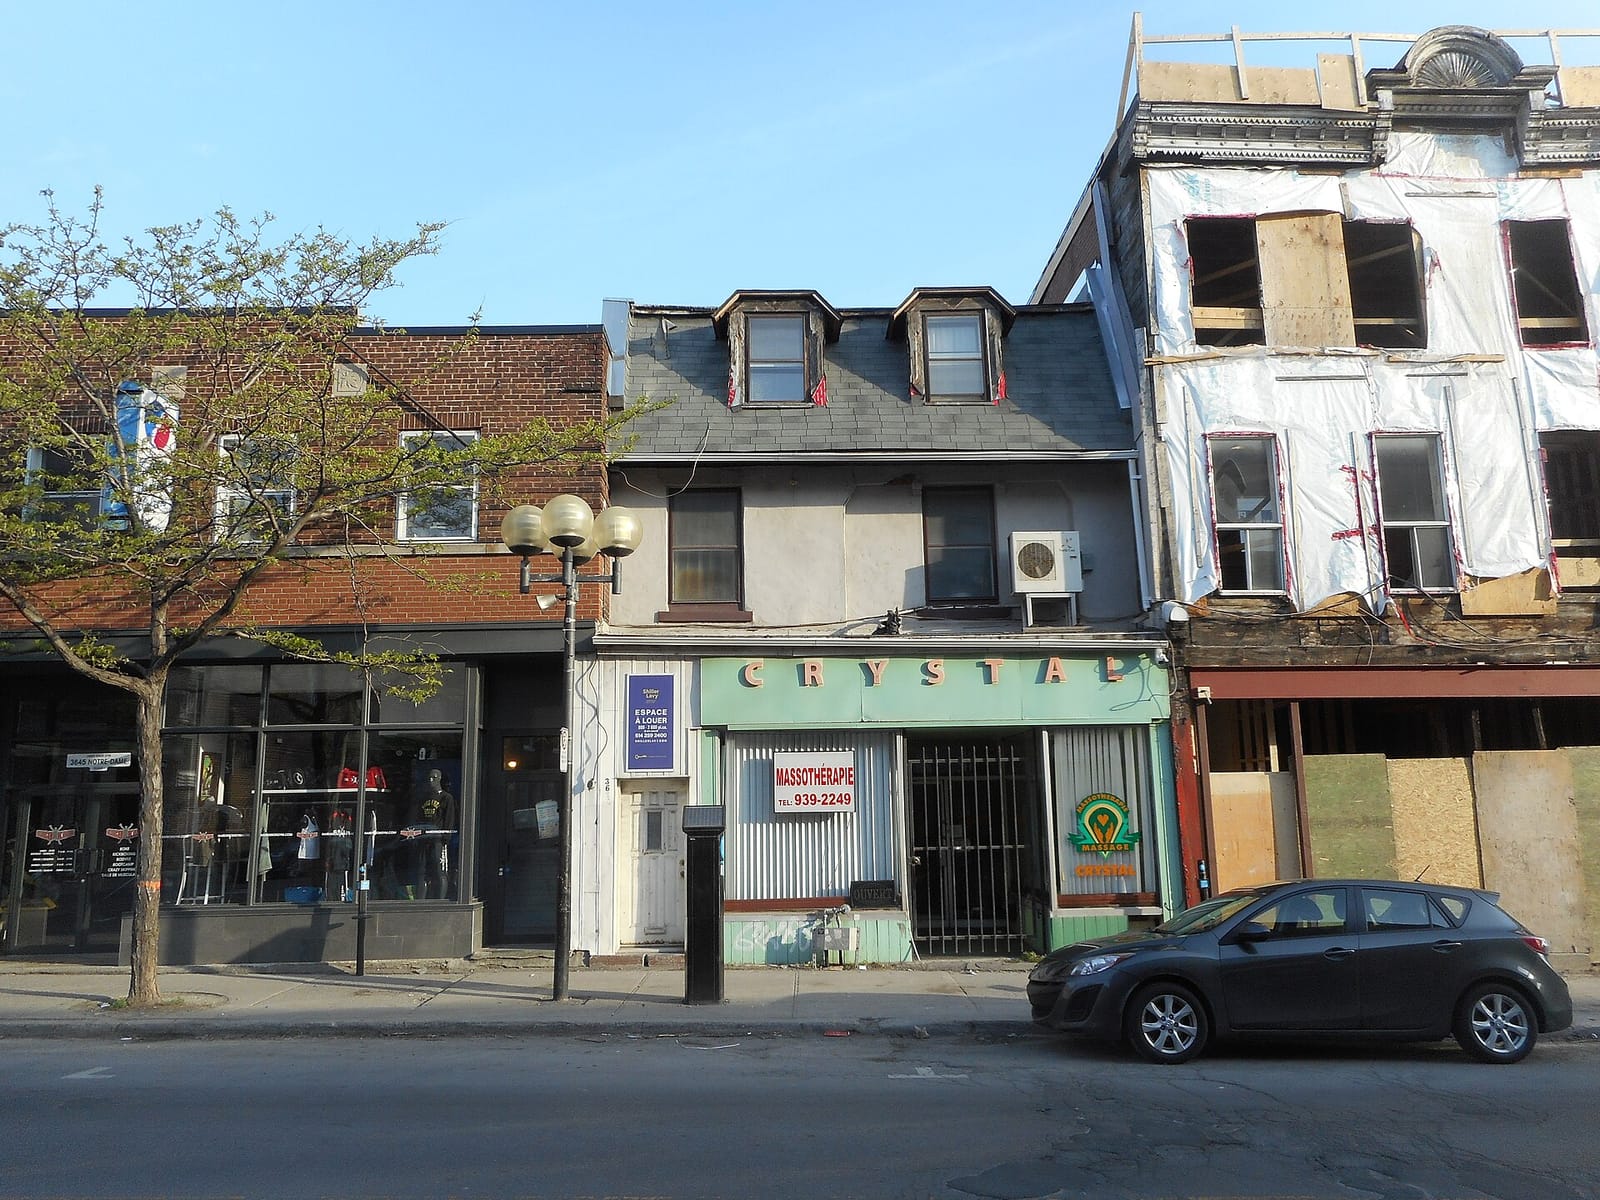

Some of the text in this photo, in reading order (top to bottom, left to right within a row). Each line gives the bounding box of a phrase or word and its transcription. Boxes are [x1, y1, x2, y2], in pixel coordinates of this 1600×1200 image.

[742, 656, 1125, 687] CRYSTAL
[634, 708, 668, 716] ESPACE
[634, 716, 641, 724] À
[776, 763, 854, 786] MASSOTHÉRAPIE
[794, 793, 852, 806] 939-2249
[1081, 843, 1130, 852] MASSAGE
[1075, 864, 1137, 878] CRYSTAL
